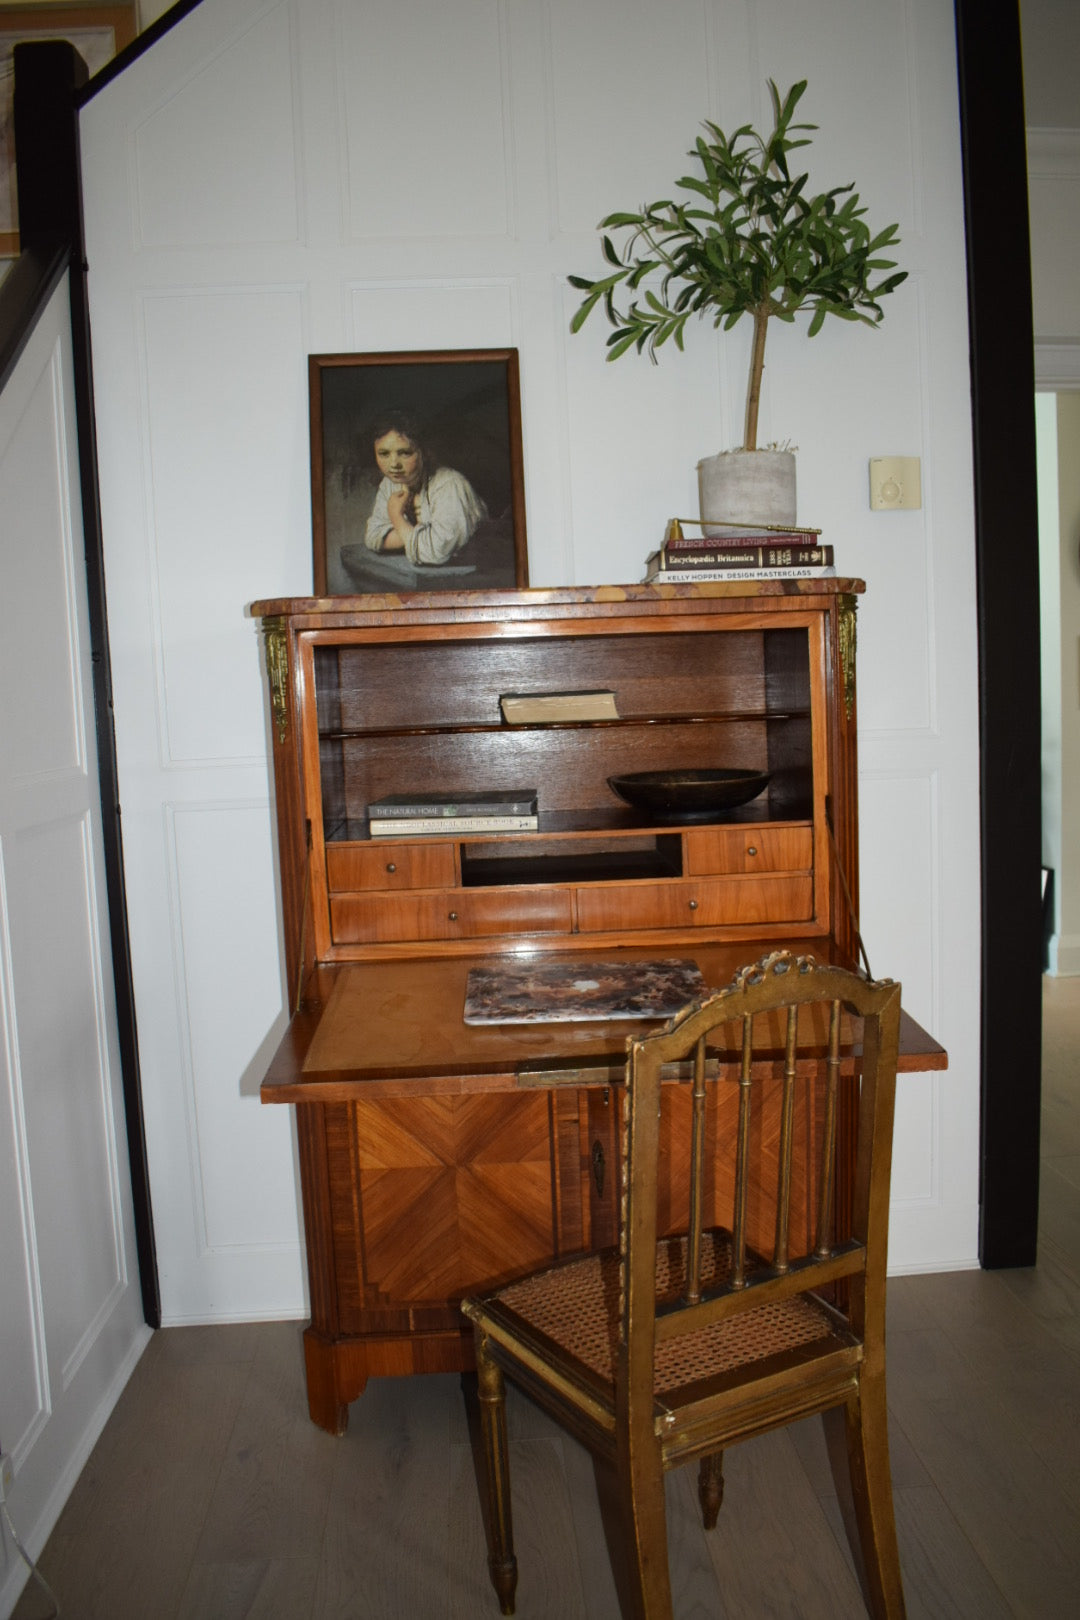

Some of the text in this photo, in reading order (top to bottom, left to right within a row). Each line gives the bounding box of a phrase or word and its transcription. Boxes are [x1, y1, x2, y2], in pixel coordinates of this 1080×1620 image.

[674, 540, 704, 549] FRENCH
[707, 539, 741, 547] COUNTRY
[742, 538, 768, 546] LIVING
[717, 553, 754, 562] Britannica
[726, 571, 755, 579] DESIGN
[756, 569, 812, 577] MASTERCLASS
[376, 807, 439, 816] THE NATURAL HOME
